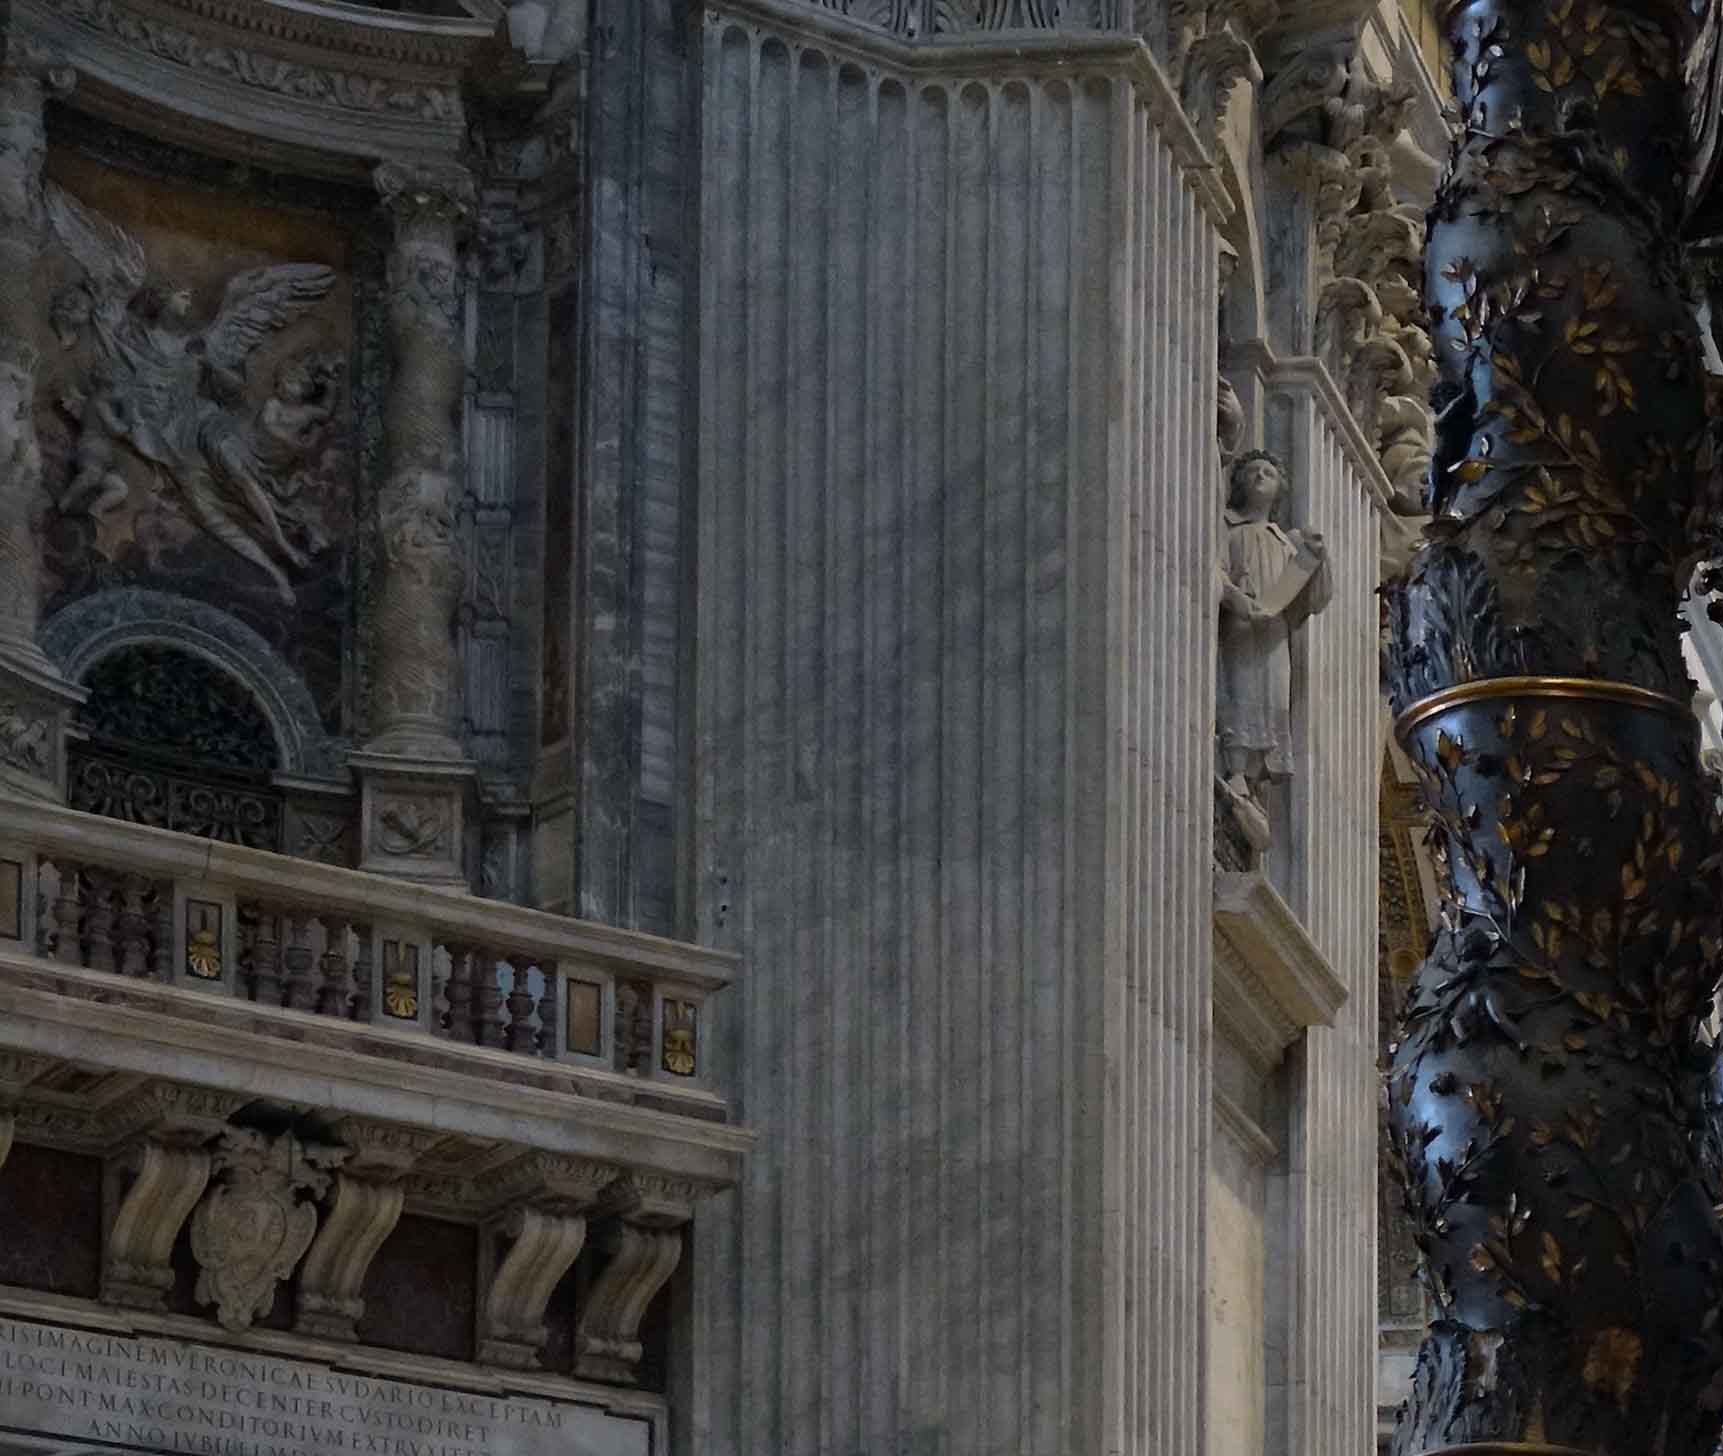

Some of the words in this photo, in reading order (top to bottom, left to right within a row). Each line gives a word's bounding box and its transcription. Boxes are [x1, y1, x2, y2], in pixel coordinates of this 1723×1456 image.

[5, 1352, 67, 1377] LOCI
[75, 1363, 194, 1397] MAIESTAS
[201, 1382, 335, 1420] DECENTER
[339, 1404, 490, 1444] CVSTODIRET
[37, 1330, 170, 1366] IMAGINEM
[172, 1351, 318, 1391] VERONICAE
[325, 1376, 433, 1409] SVDARIO
[90, 1419, 167, 1447] ANNO
[99, 1393, 152, 1417] MAX
[158, 1402, 345, 1448] CONDITORIVM
